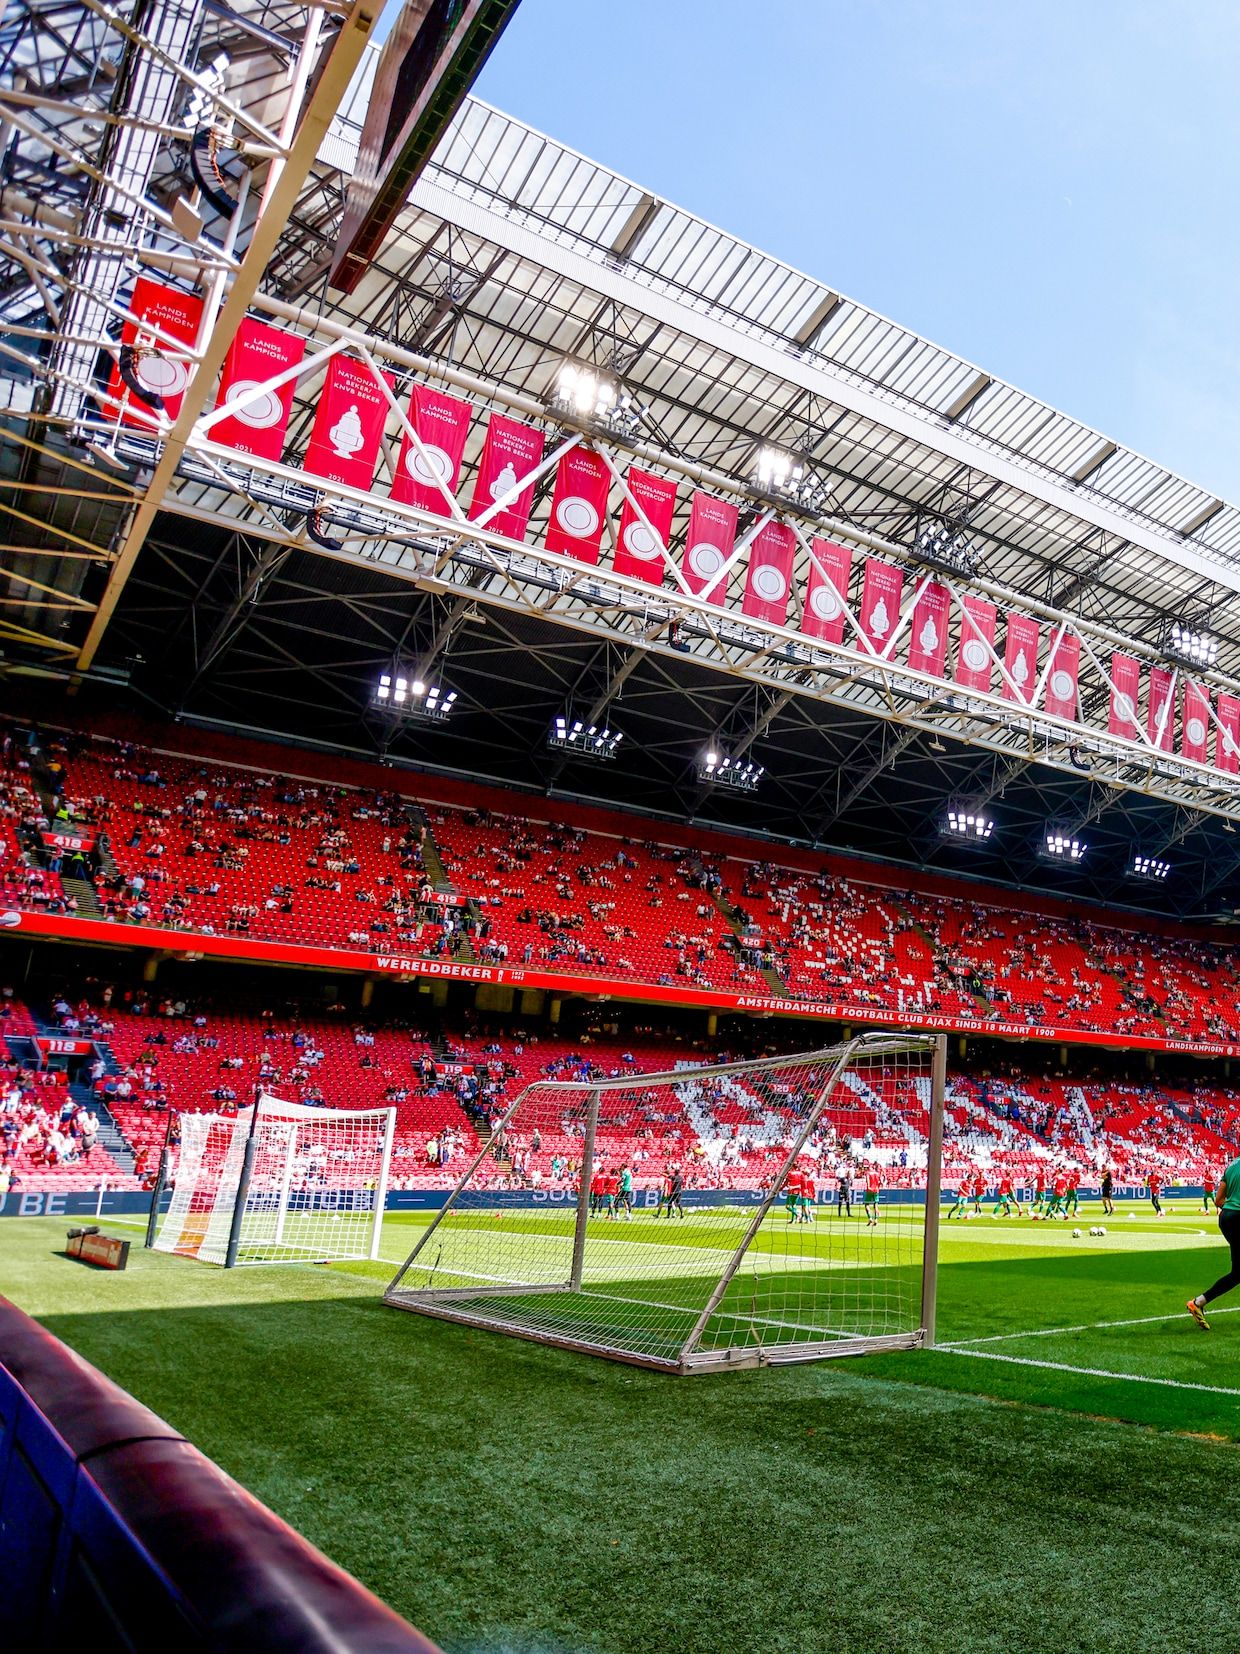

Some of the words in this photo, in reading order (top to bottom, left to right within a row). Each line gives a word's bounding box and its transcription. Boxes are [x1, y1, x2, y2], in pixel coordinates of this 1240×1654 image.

[156, 302, 187, 318] LANDS
[146, 307, 194, 329] KAMPIOEN
[244, 342, 288, 362] KAMPIOEN
[253, 338, 282, 352] LANDS
[338, 369, 382, 392] NATIONALE
[346, 379, 372, 394] BEKER/
[334, 382, 356, 396] KNVB
[356, 389, 380, 404] BEKER
[420, 408, 458, 426] KAMPIOEN
[428, 404, 452, 418] LANDS
[496, 429, 536, 449] NATIONALE
[502, 438, 526, 450] BEKER/
[234, 442, 253, 454] 2021
[492, 440, 511, 452] KNVB
[512, 447, 533, 460] BEKER
[568, 462, 602, 478] KAMPIOEN
[575, 459, 597, 470] LANDS
[328, 472, 345, 484] 2021
[631, 480, 672, 500] NEDERLANDSE
[636, 488, 666, 503] SUPERCUP
[413, 501, 429, 511] 2019
[700, 512, 728, 526] KAMPIOEN
[706, 508, 724, 519] LANDS
[488, 526, 504, 535] 2019
[766, 531, 784, 542] LANDS
[761, 535, 788, 549] KAMPIOEN
[822, 552, 840, 562] LANDS
[870, 570, 897, 584] NATIONALE
[924, 592, 945, 602] ATIONALE
[53, 836, 82, 848] 418
[437, 894, 457, 904] 419
[743, 938, 760, 946] 420
[377, 958, 492, 979] WERELDBEKER
[737, 997, 837, 1014] AMSTERDAMSCHE
[842, 1008, 894, 1021] FOOTBALL
[898, 1014, 922, 1024] CLUB
[926, 1018, 951, 1027] AJAX
[955, 1020, 982, 1029] SINDS
[999, 1025, 1030, 1034] MAART
[1035, 1028, 1055, 1036] 1900
[49, 1040, 76, 1051] 118
[1166, 1042, 1224, 1053] LANDSKAMPIOEN
[444, 1065, 463, 1074] 119
[19, 1192, 68, 1215] BE
